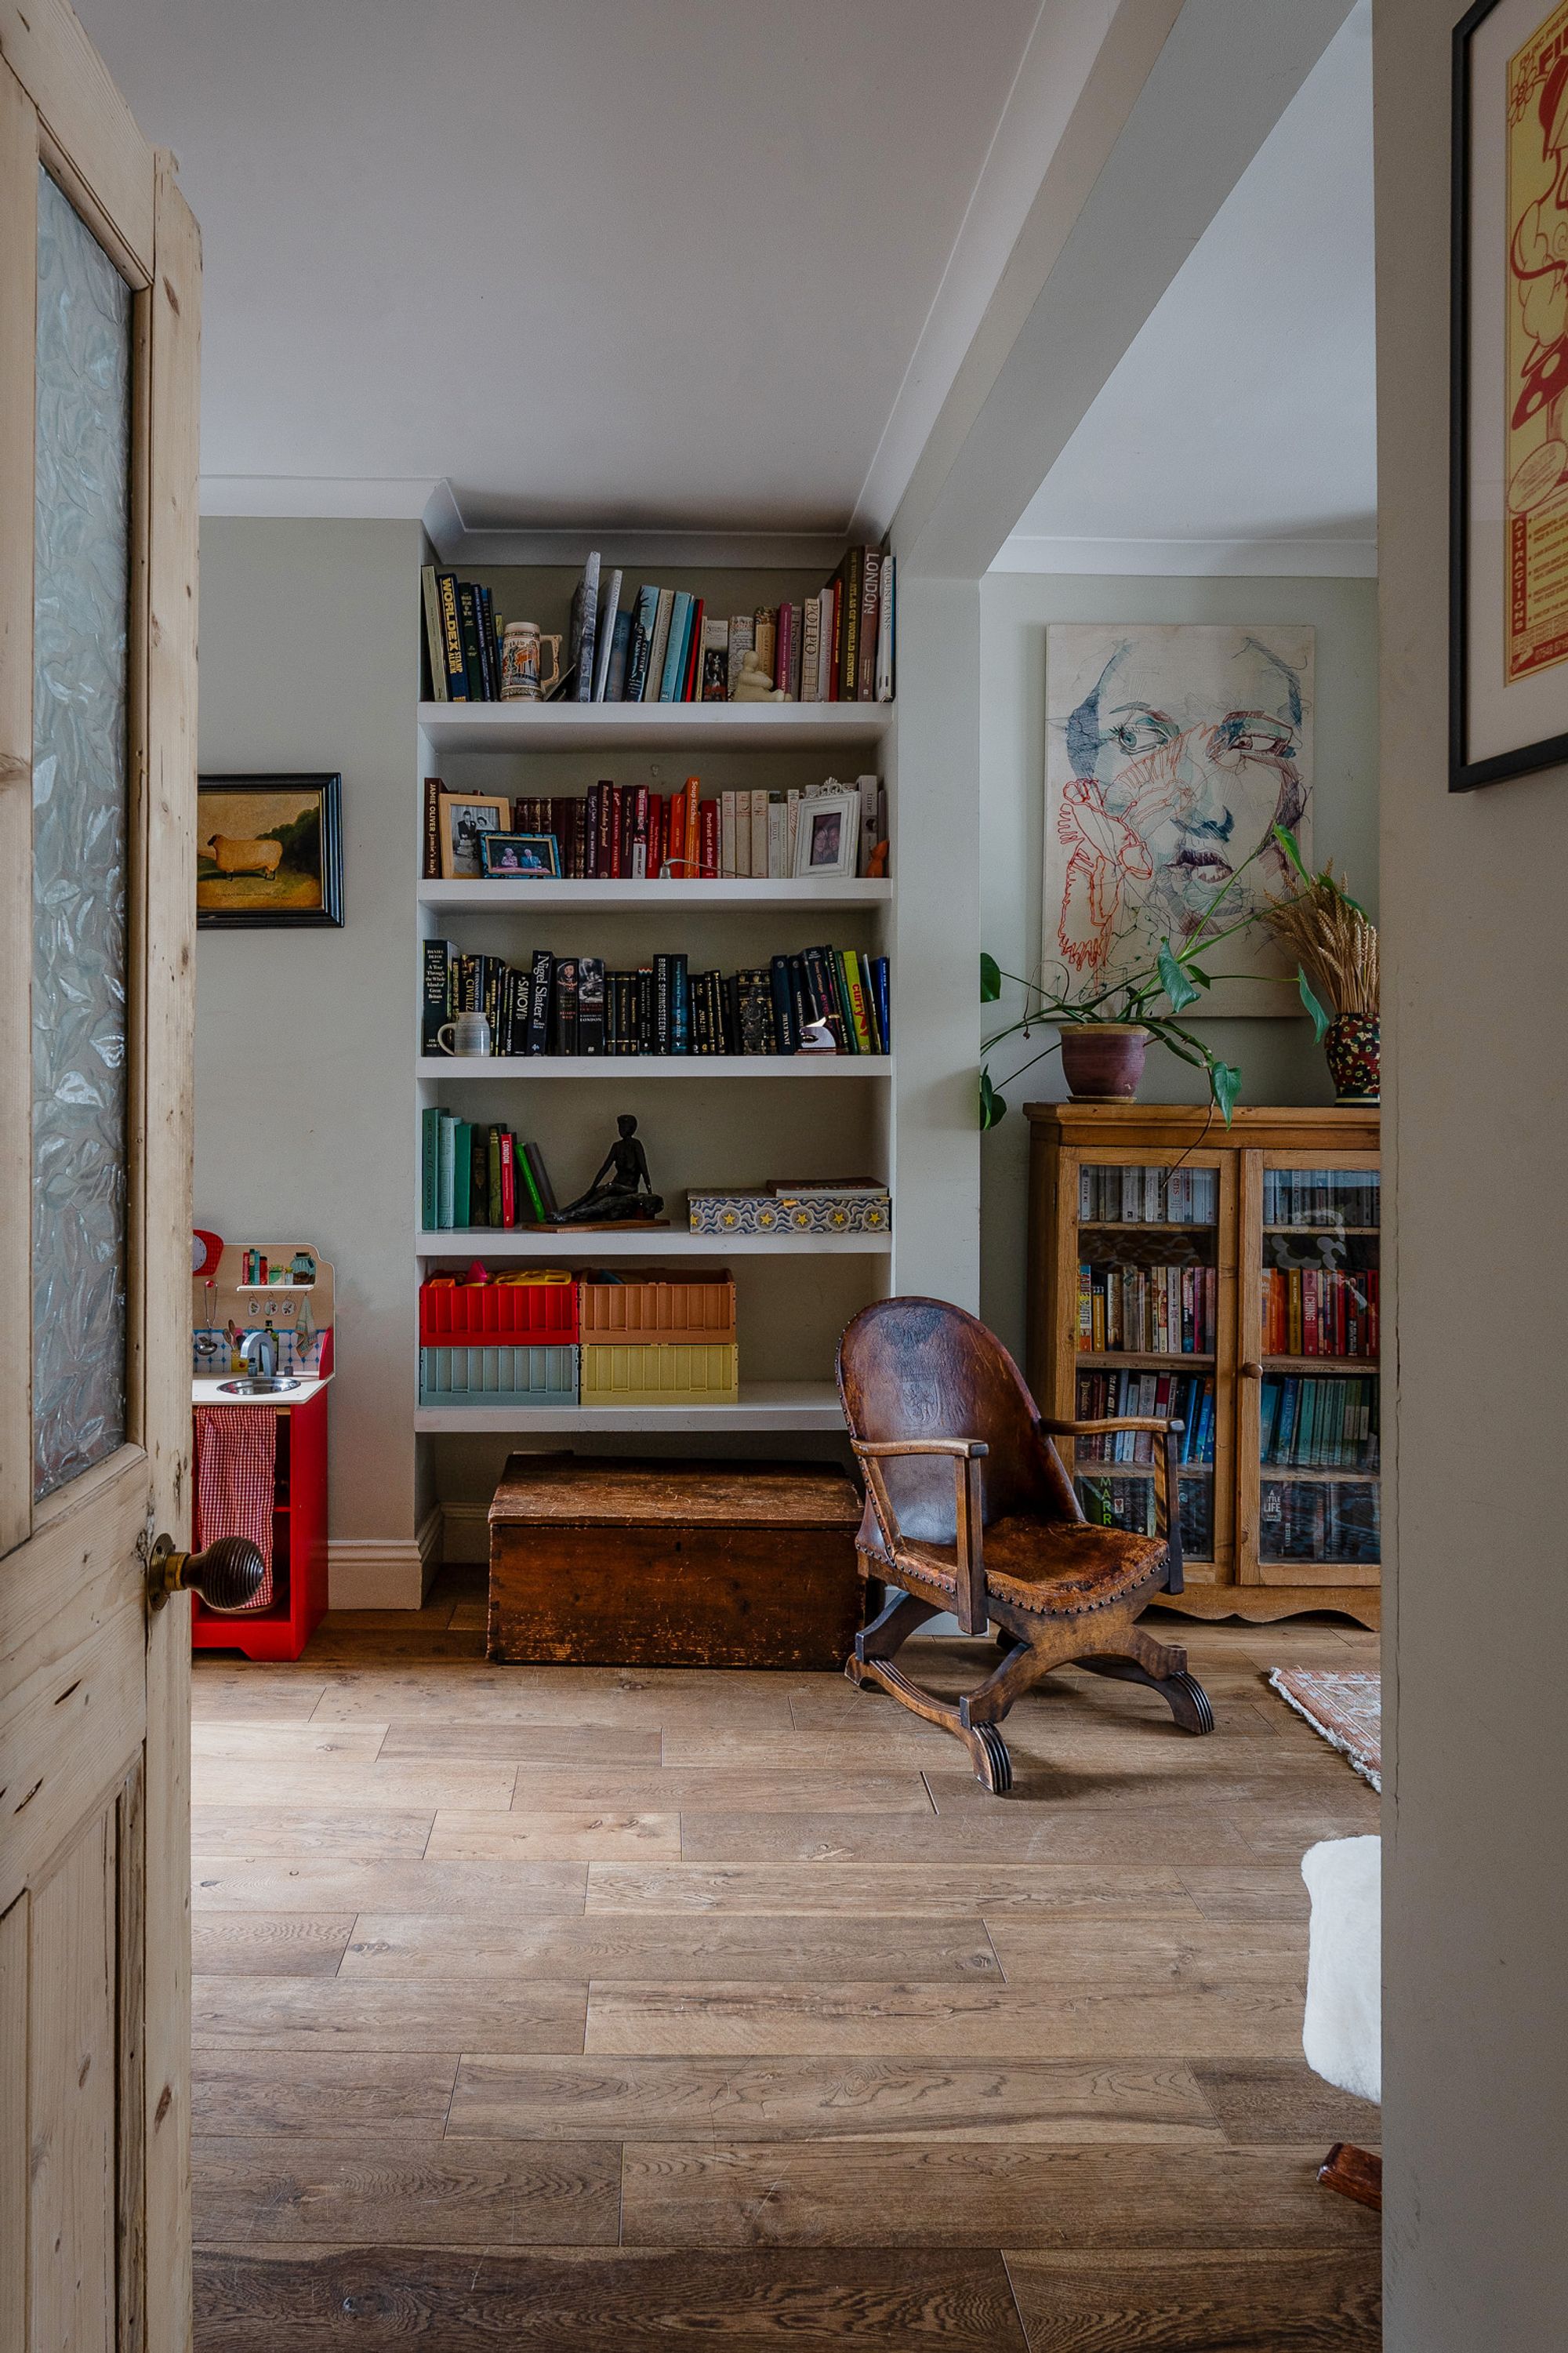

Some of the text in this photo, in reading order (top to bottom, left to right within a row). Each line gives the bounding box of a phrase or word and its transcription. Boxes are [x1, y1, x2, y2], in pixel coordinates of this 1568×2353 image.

[864, 553, 879, 615] LONDON
[1514, 521, 1525, 630] ATTRACTIONS
[849, 583, 858, 608] ATLAS
[442, 578, 460, 652] WORLDEX
[805, 603, 818, 655] POLPO
[848, 609, 857, 619] OF
[790, 621, 800, 656] Persiana
[848, 622, 856, 652] WORLD
[638, 643, 647, 673] CENTURY
[846, 652, 855, 688] HISTORY
[428, 859, 437, 875] italy
[466, 979, 474, 1012] CIVILIZ
[517, 980, 528, 1014] SAVOY
[533, 955, 549, 1019] Nigel Slater
[852, 984, 864, 1016] curry
[1080, 1301, 1091, 1324] SMITH
[1305, 1296, 1316, 1321] CHING
[1263, 1502, 1281, 1512] LIFE
